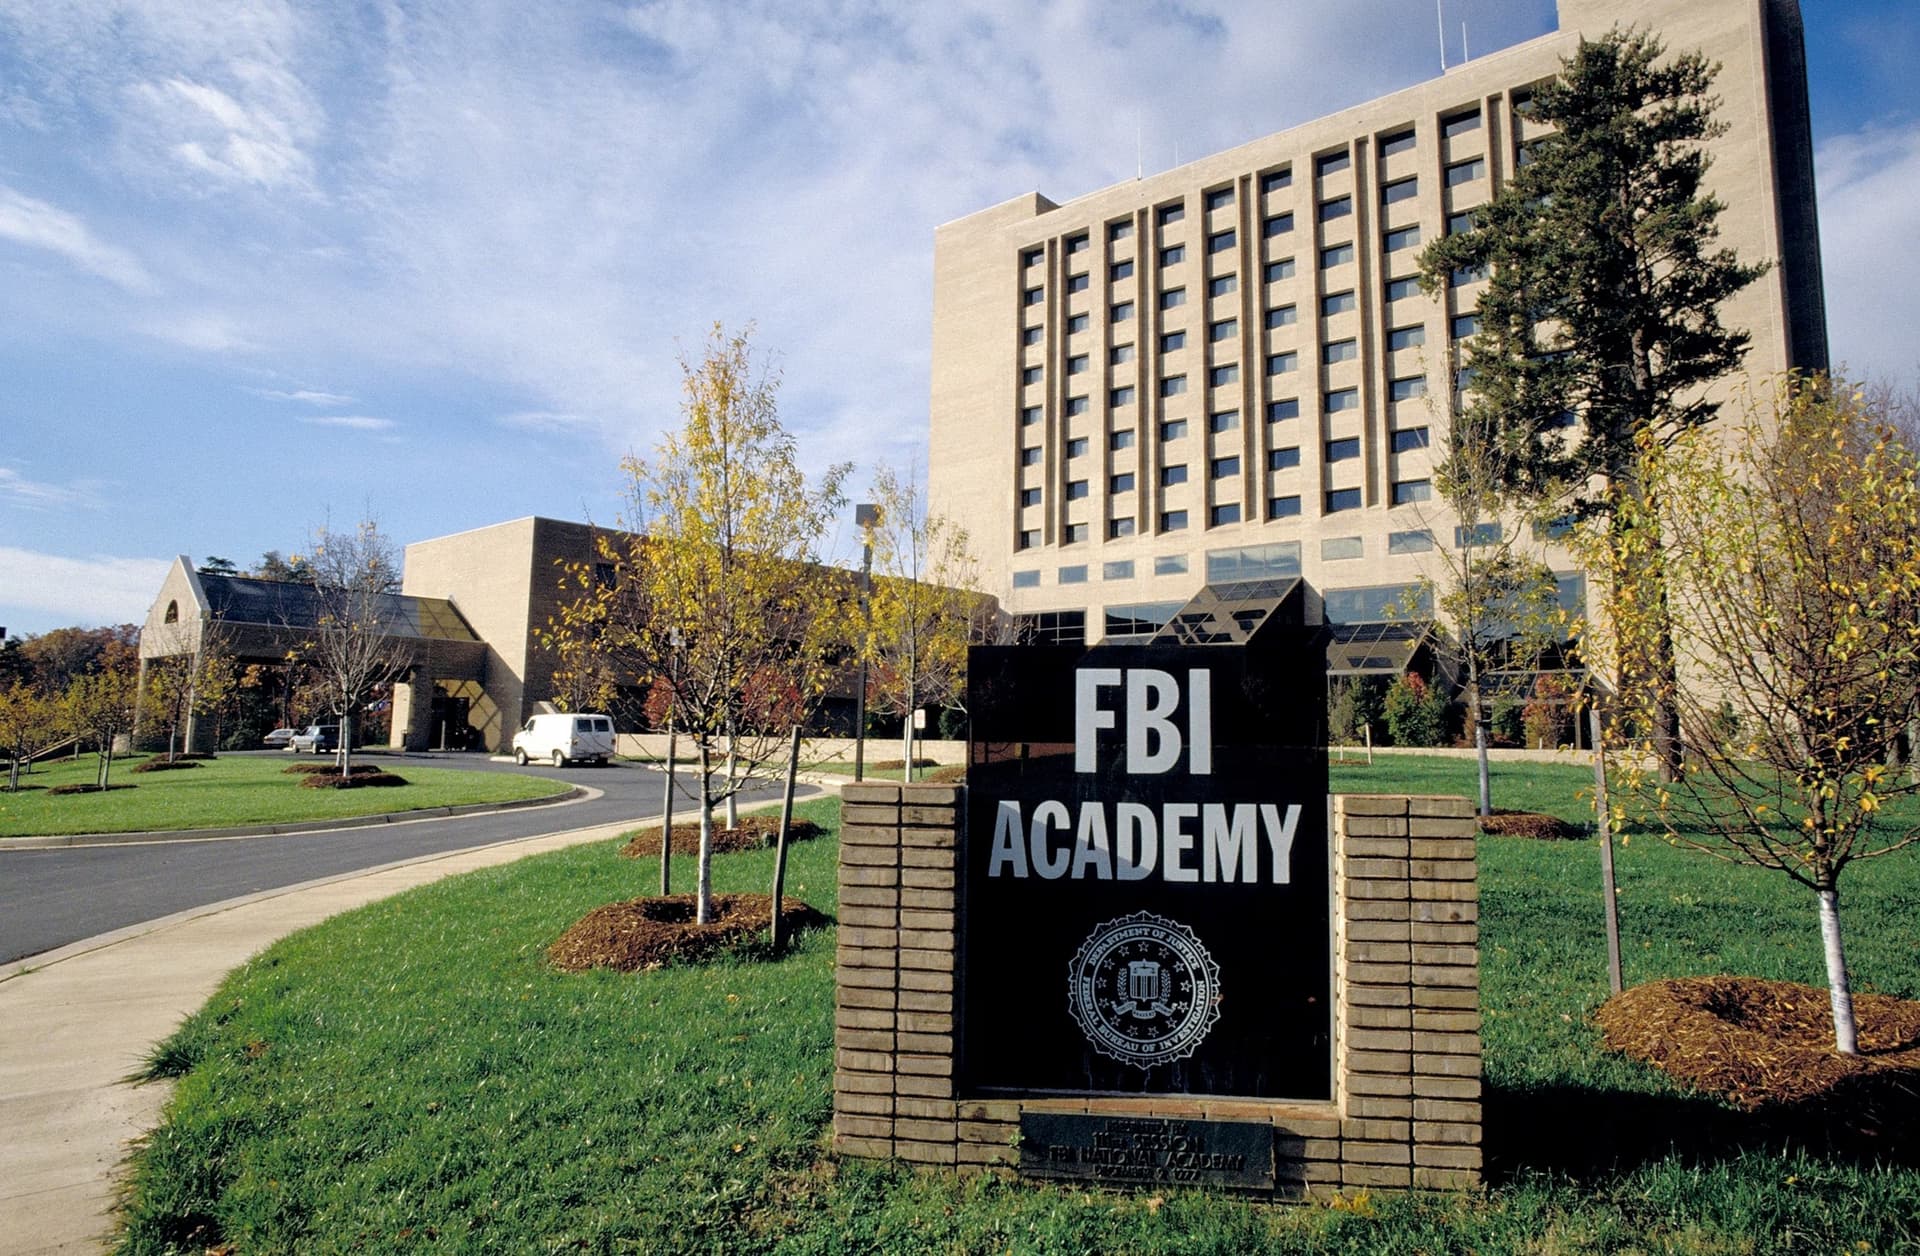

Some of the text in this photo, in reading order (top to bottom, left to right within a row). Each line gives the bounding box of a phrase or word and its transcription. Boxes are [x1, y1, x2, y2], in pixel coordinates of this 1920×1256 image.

[1075, 668, 1212, 775] FBI
[988, 800, 1302, 884] ACADEMY
[1088, 927, 1201, 970] DEPARTMENT OF JUSTICE
[1082, 976, 1206, 1053] FEDERAL BUREAU OF INVESTIGATION
[1049, 1144, 1245, 1171] FBI NATIONAL ACADEMY
[1132, 1133, 1204, 1153] SESSION
